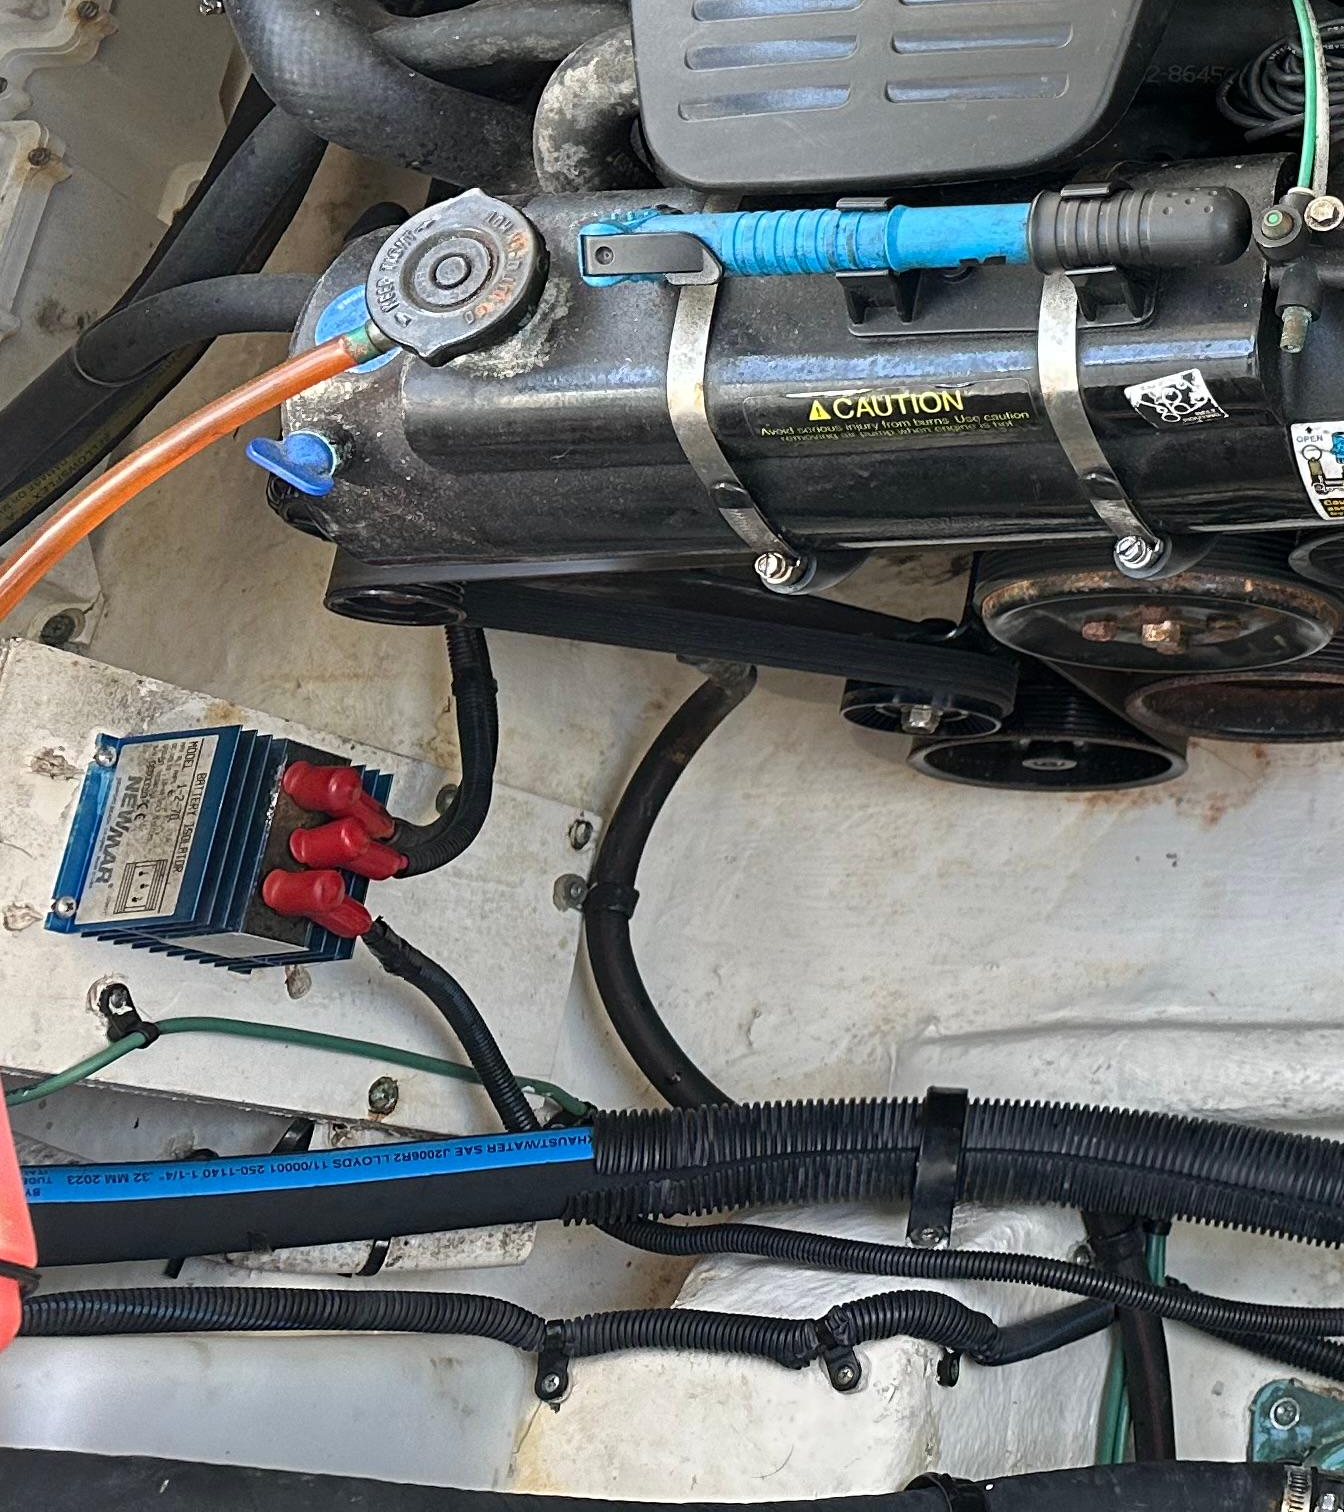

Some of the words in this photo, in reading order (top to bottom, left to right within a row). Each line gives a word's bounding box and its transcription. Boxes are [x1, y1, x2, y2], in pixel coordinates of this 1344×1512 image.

[832, 390, 963, 419] CAUTION
[761, 424, 795, 436] Avoid
[846, 422, 879, 433] injury
[882, 419, 910, 428] from
[954, 414, 980, 424] Use
[983, 411, 1029, 421] caution
[181, 741, 197, 770] MODEL
[187, 772, 207, 816] BATTERY
[95, 776, 140, 884] NEWMAR
[174, 823, 194, 872] ISOLATOR
[394, 1146, 450, 1163] J2006R2
[455, 1145, 483, 1157] SAE
[270, 1159, 329, 1174] 11/00001
[332, 1153, 390, 1169] LLOYDS
[66, 1173, 101, 1185] 2023
[104, 1172, 129, 1184] MM
[203, 1163, 265, 1178] 250-1140
